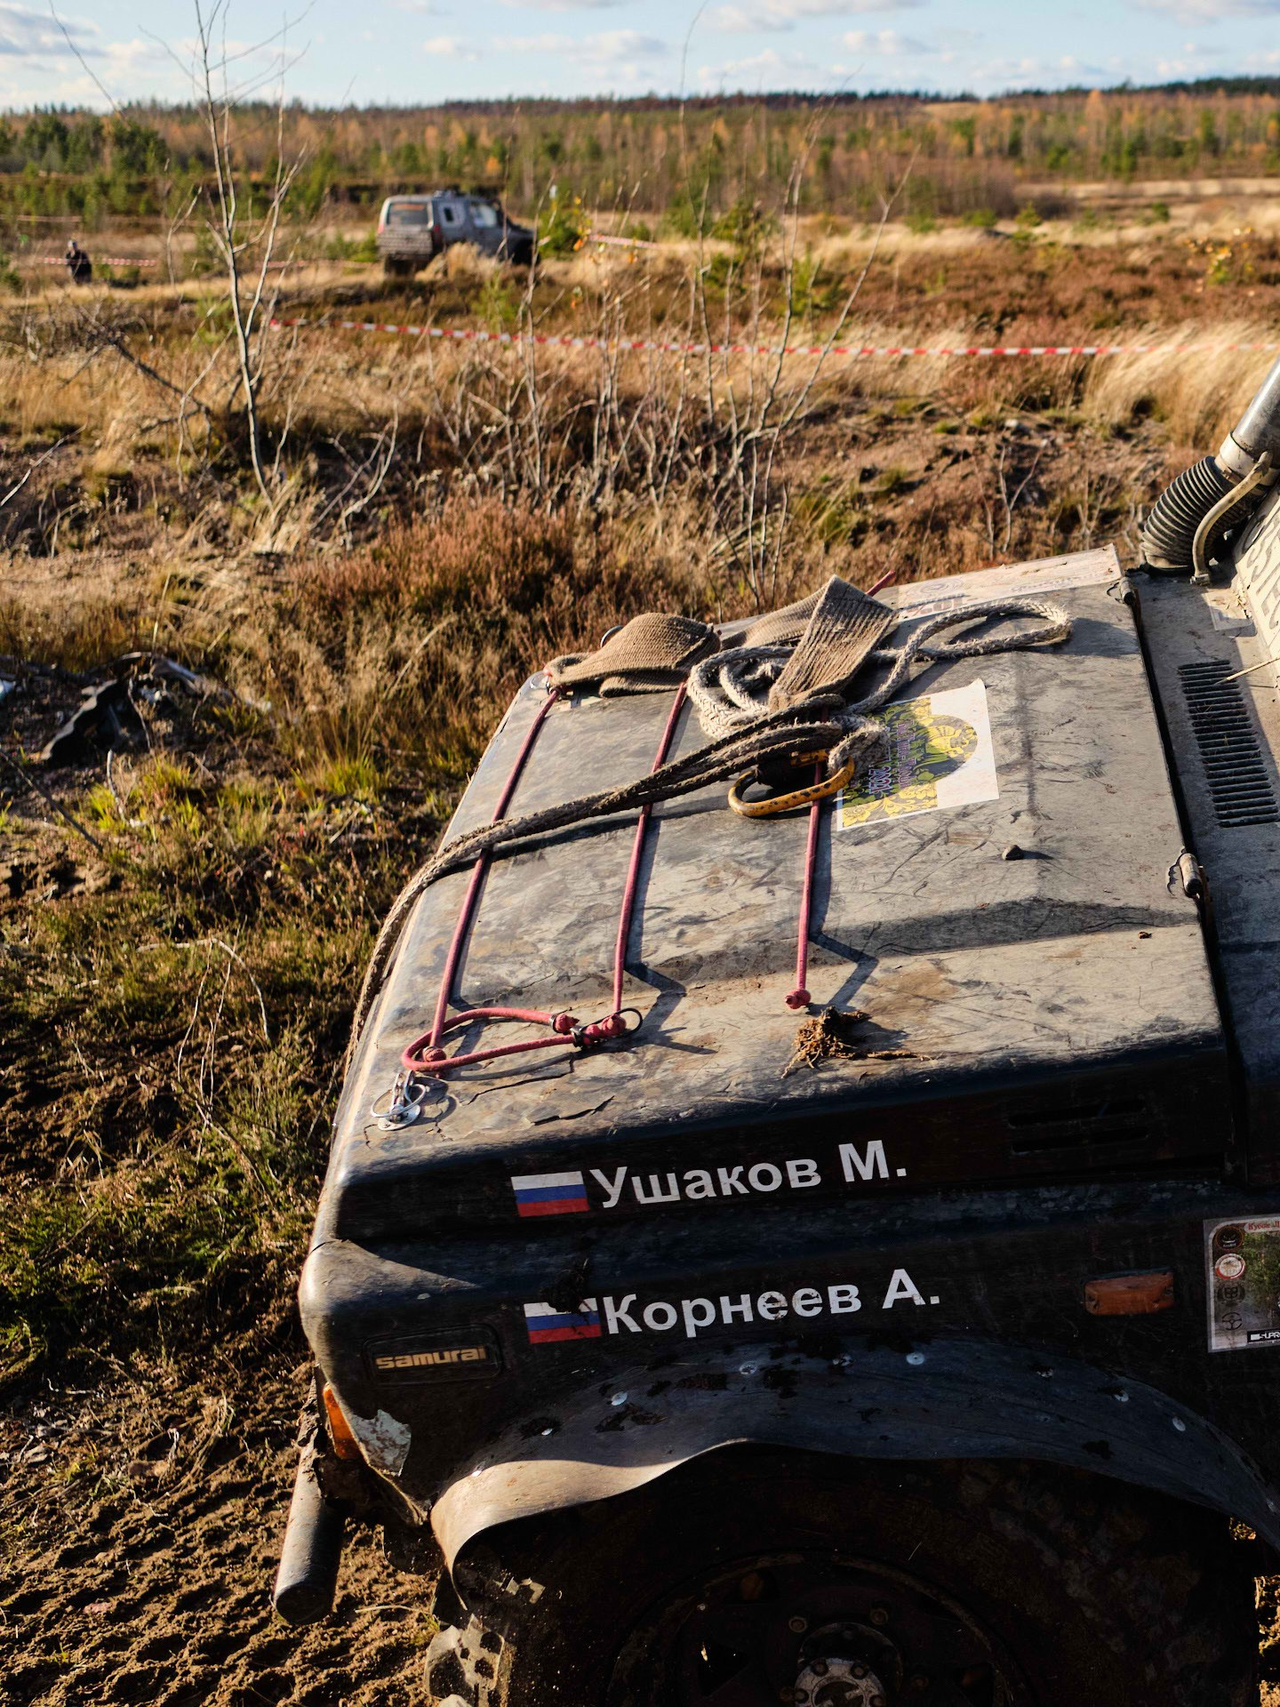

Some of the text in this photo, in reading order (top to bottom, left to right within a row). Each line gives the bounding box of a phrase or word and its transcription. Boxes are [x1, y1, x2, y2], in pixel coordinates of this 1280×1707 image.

[589, 1139, 907, 1209] Ушаков М.
[603, 1268, 940, 1338] Корнеев А.
[375, 1346, 487, 1370] samurai
